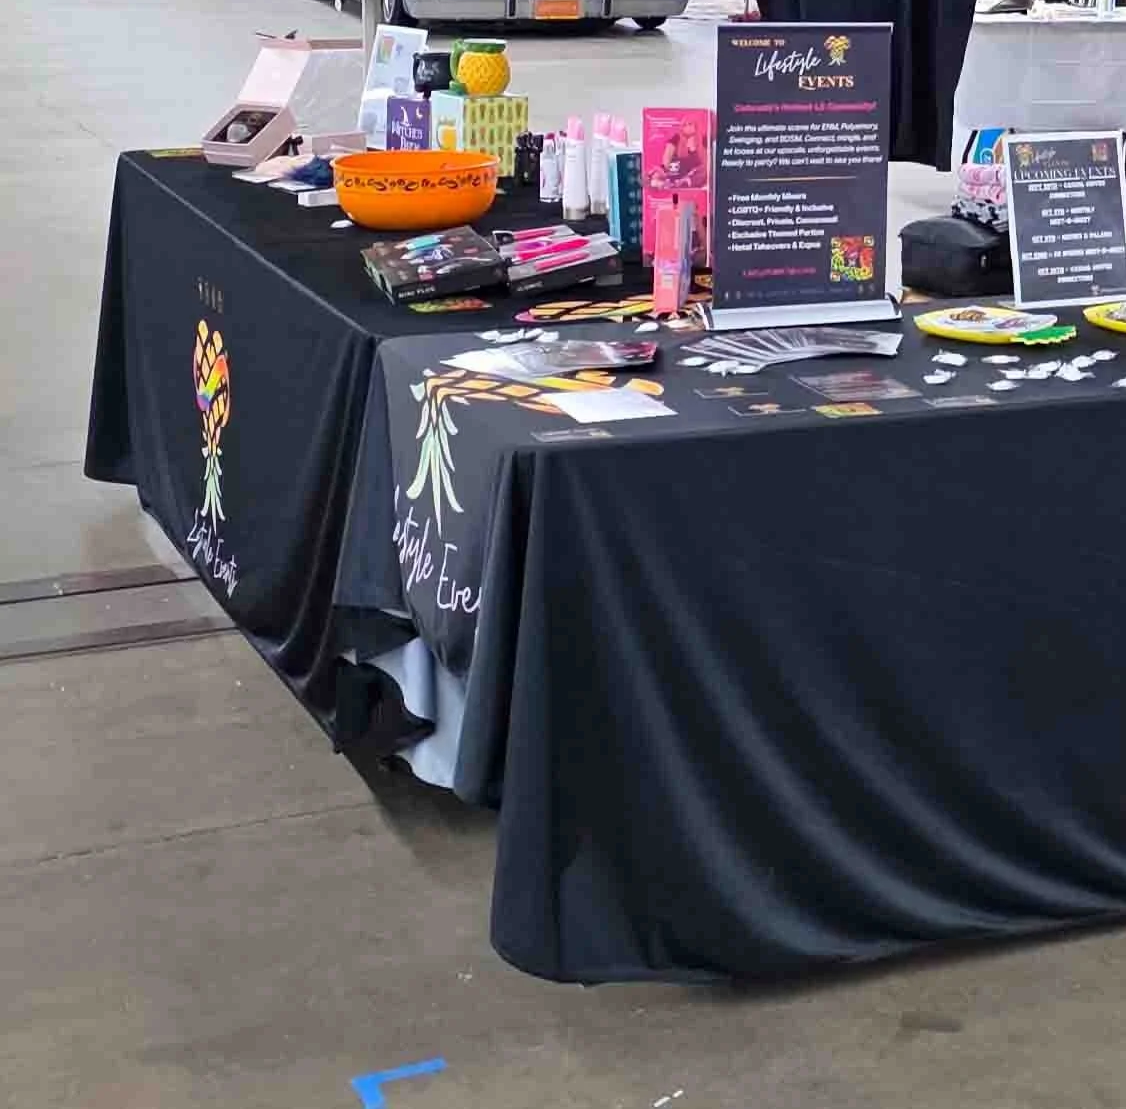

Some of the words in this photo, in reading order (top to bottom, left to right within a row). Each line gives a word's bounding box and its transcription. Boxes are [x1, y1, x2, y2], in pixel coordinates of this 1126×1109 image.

[774, 38, 785, 46] TO
[754, 46, 822, 82] Lifestyle
[798, 75, 855, 90] EVENTS
[732, 194, 750, 202] Free
